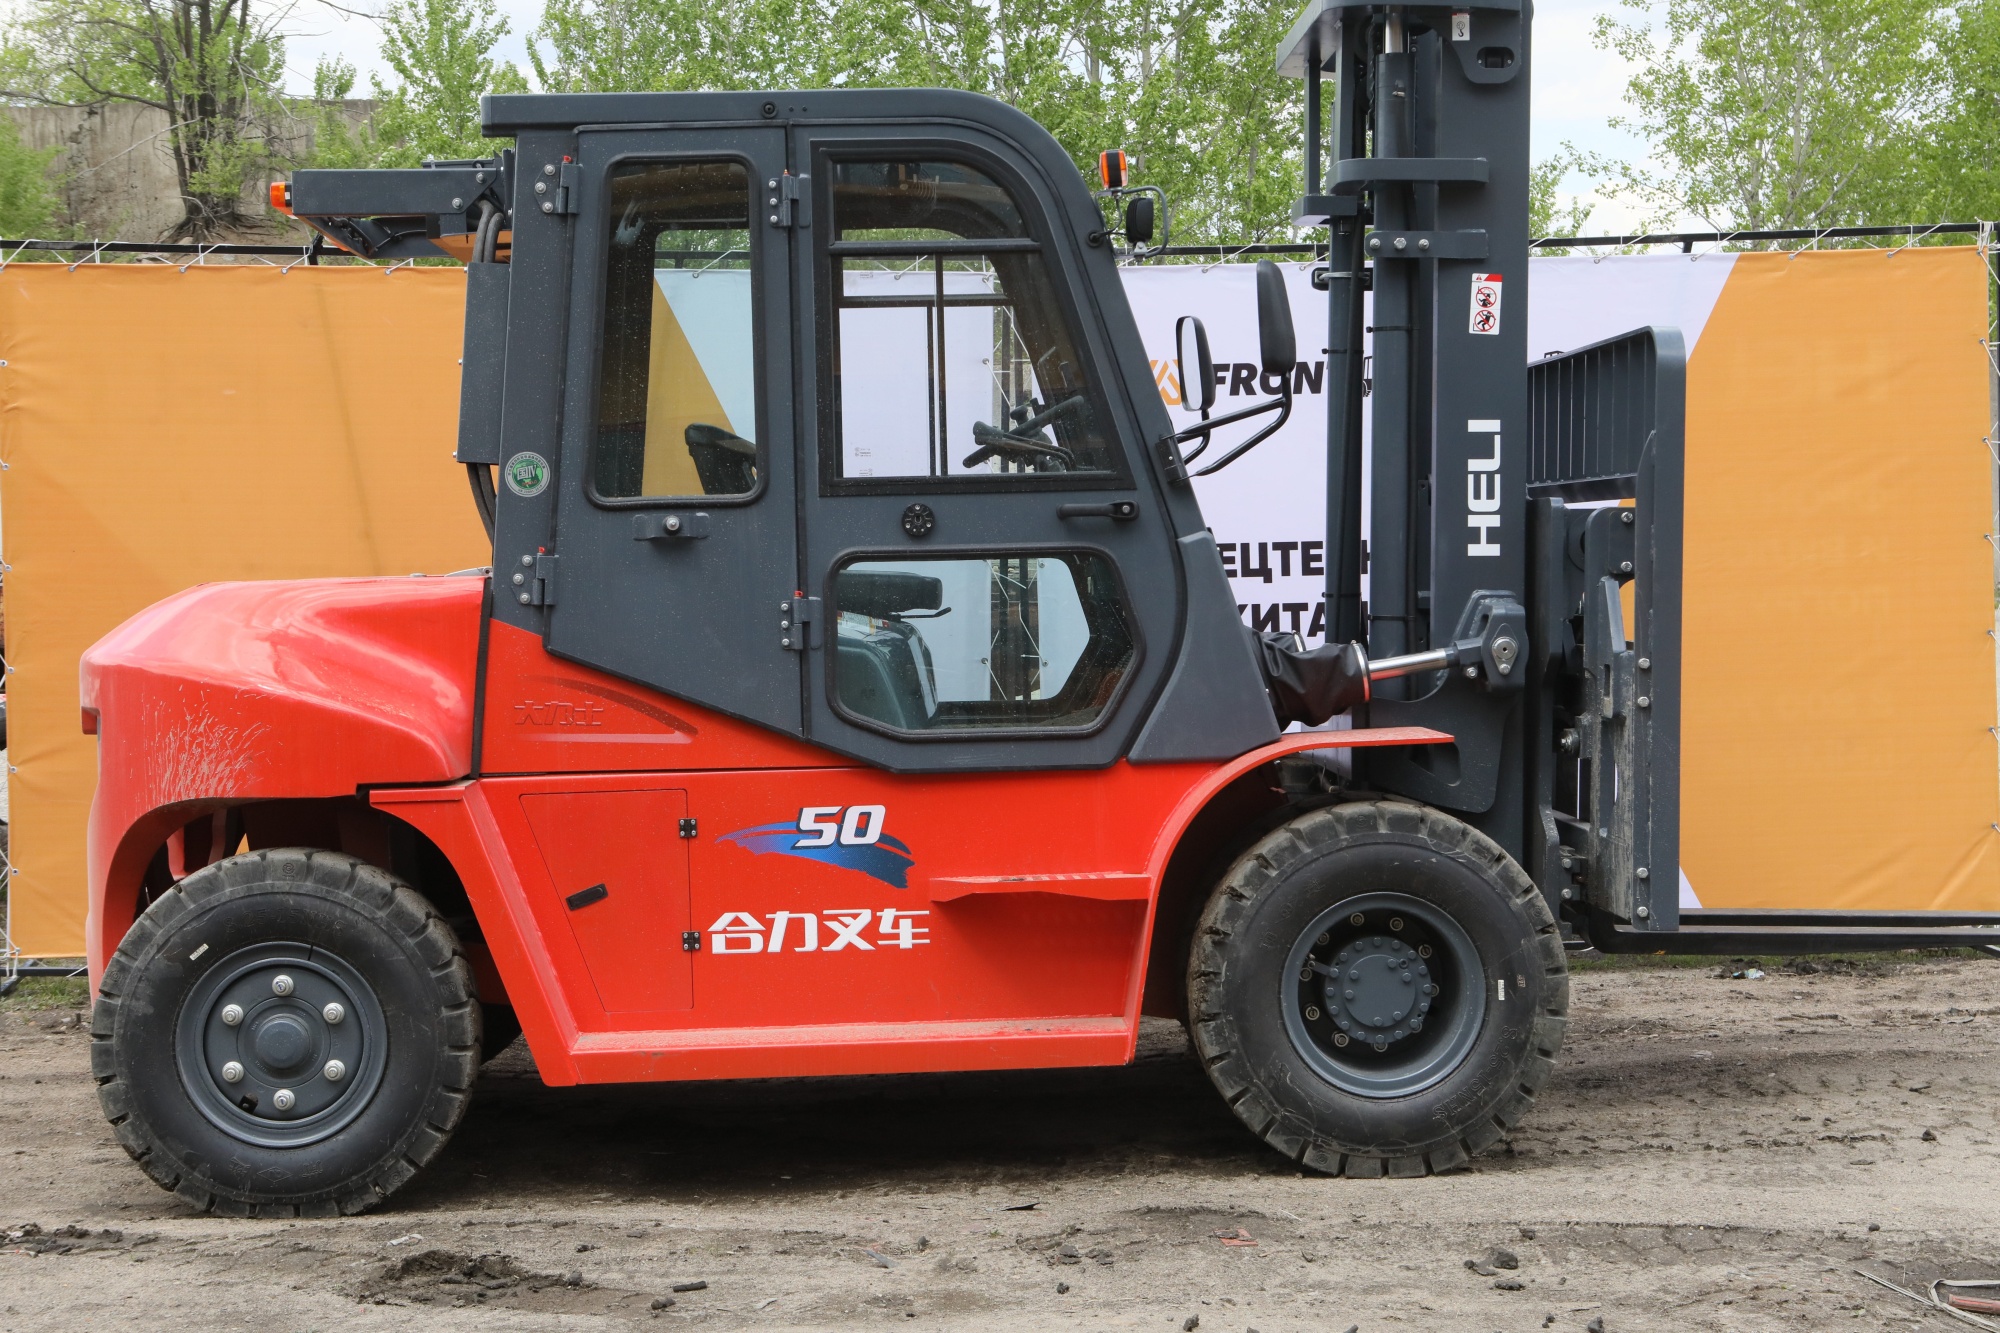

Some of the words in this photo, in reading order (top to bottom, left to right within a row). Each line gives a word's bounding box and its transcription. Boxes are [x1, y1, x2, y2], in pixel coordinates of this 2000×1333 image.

[1212, 361, 1328, 396] FRON
[1467, 419, 1501, 557] HELI
[514, 700, 604, 726] 大力士
[792, 804, 886, 849] 50
[707, 908, 931, 955] 合力叉车
[1432, 1025, 1519, 1120] 8.25-15NHS
